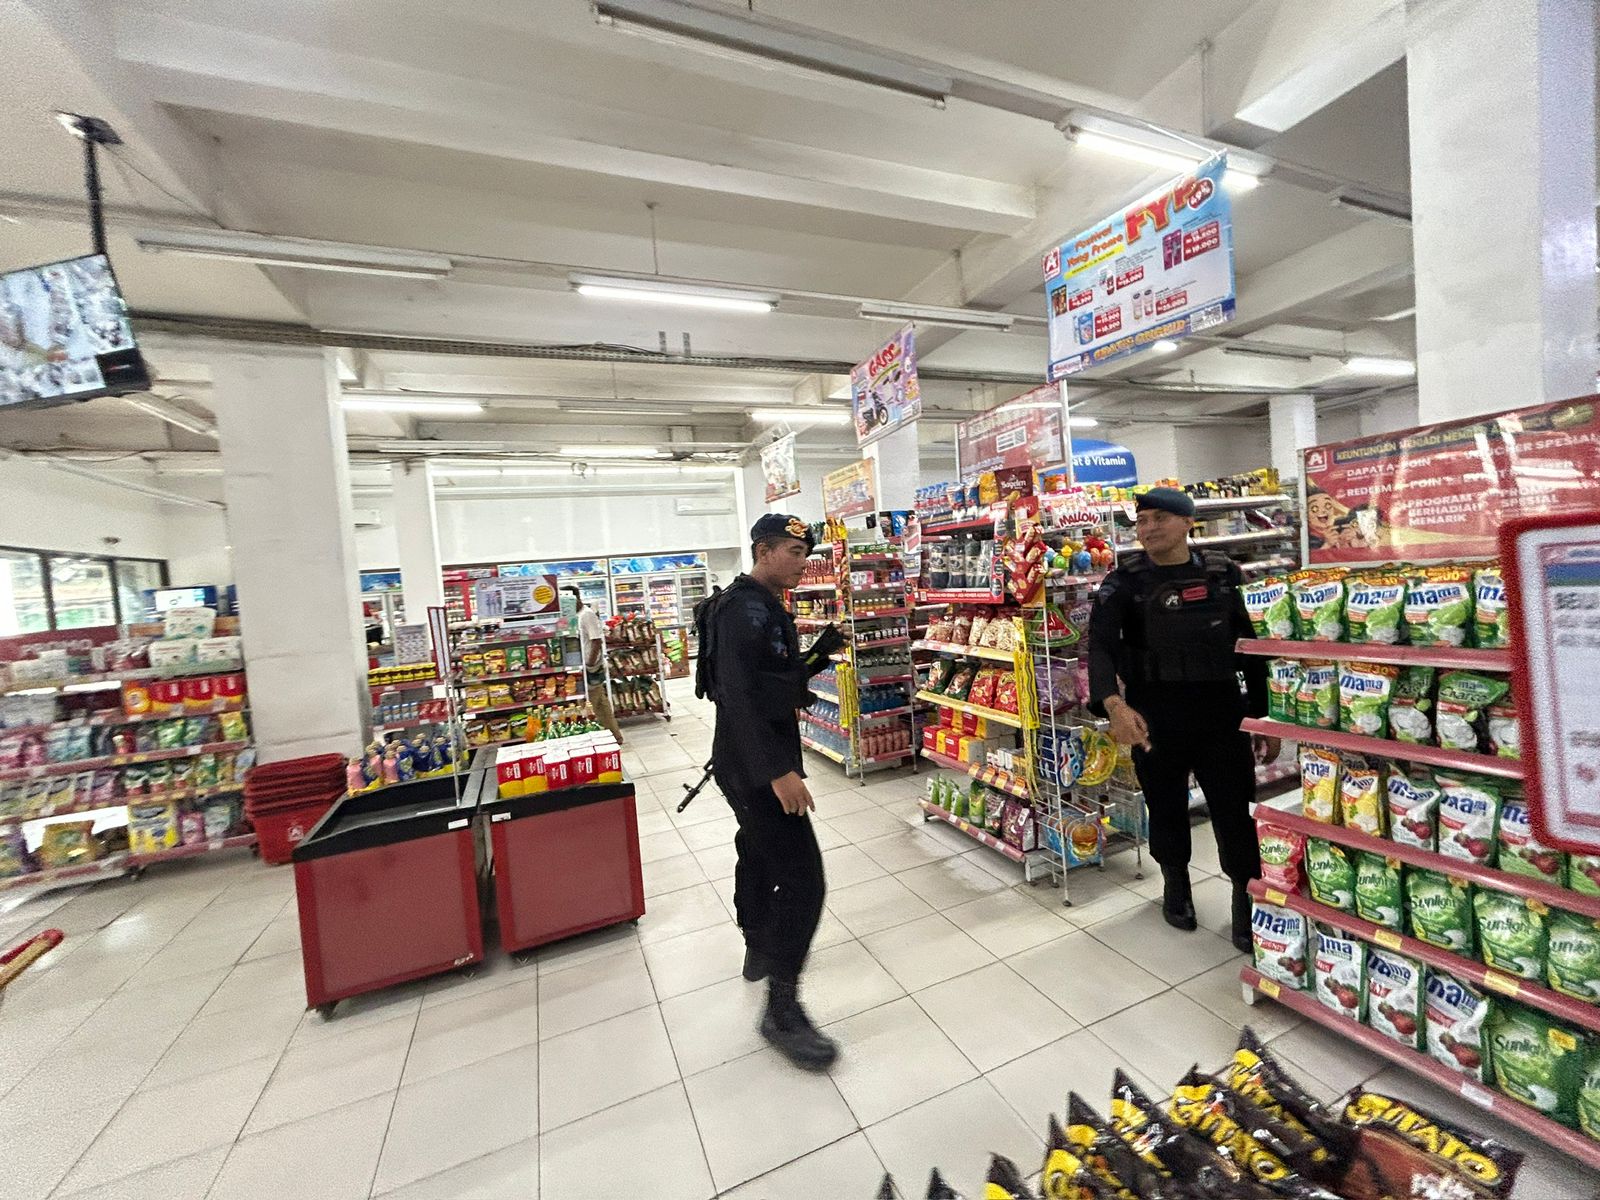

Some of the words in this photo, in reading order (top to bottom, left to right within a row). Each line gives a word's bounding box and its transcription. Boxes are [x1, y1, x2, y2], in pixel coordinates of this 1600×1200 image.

[1125, 176, 1200, 244] FYP
[1092, 456, 1126, 466] Vitamin
[1347, 464, 1384, 477] DAPAT
[1347, 484, 1392, 497] REDEEM
[1408, 493, 1472, 508] PROGRAM
[1408, 514, 1467, 526] MENARIK
[1407, 586, 1461, 605] mama
[1339, 674, 1384, 692] mama
[1252, 908, 1300, 935] mama
